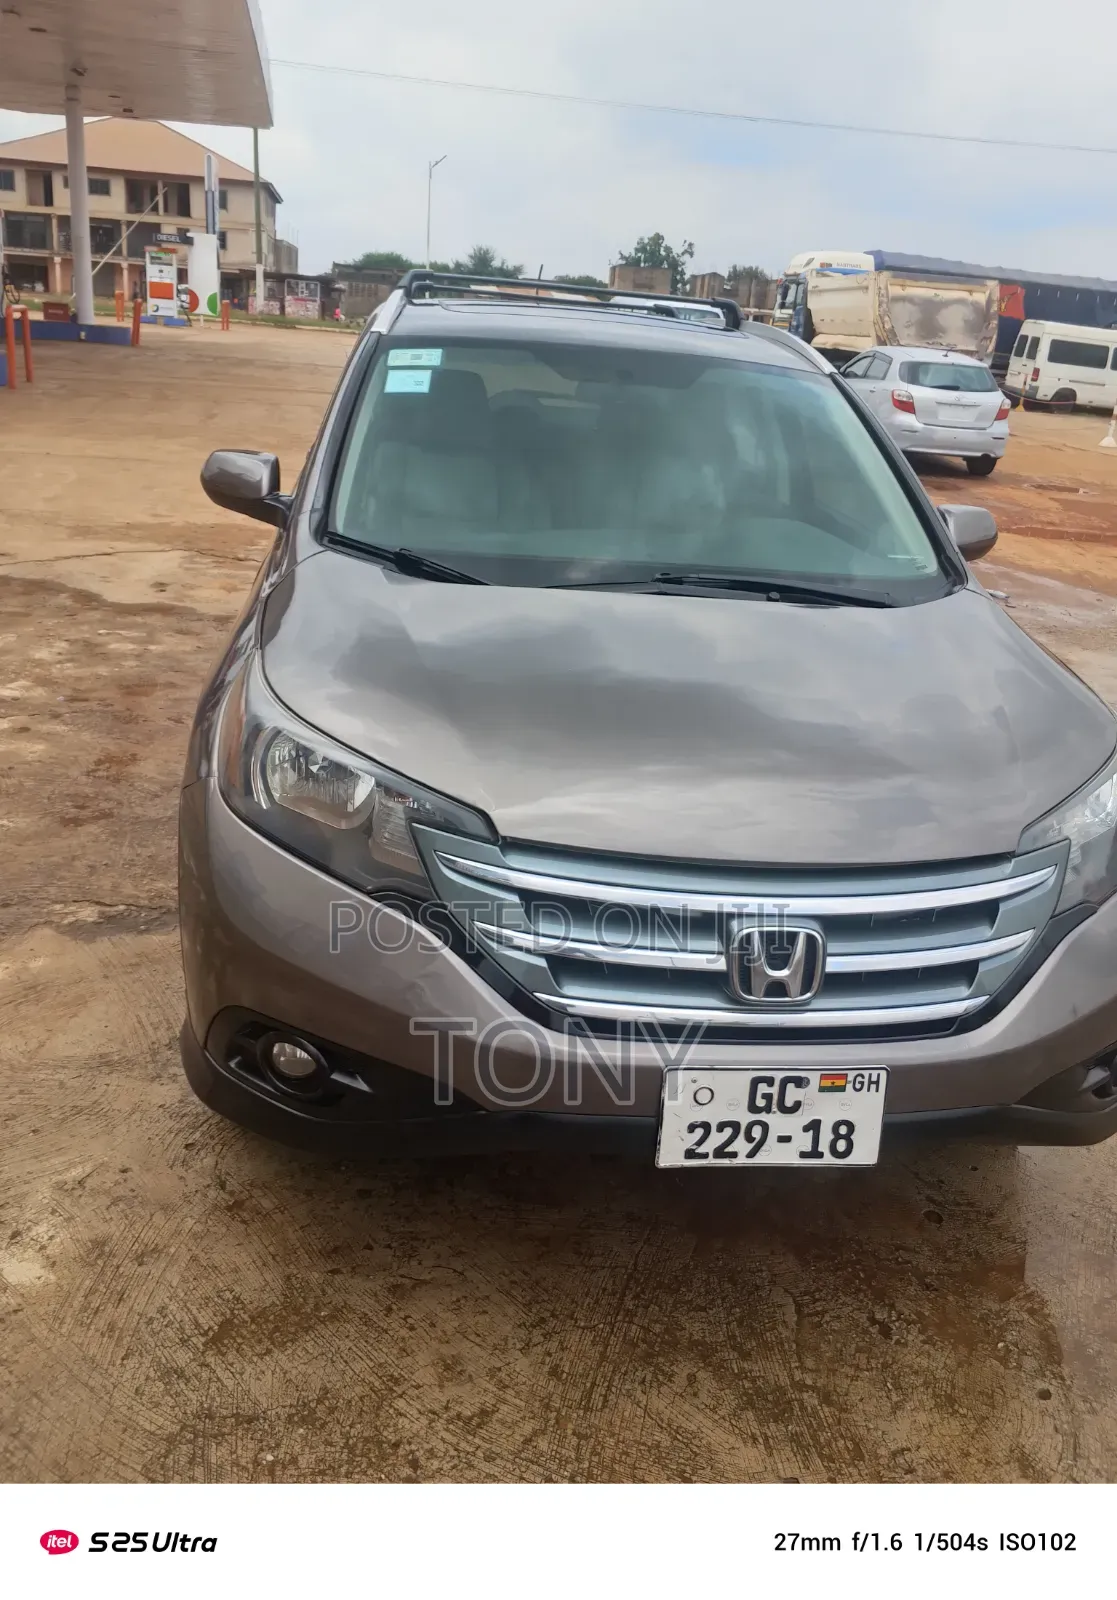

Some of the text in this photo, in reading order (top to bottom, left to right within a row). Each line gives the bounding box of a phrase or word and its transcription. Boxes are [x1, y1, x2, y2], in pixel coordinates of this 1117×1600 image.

[156, 234, 181, 242] DIESEL
[747, 1075, 804, 1115] GC
[851, 1072, 881, 1093] GH
[683, 1118, 856, 1160] 229-18
